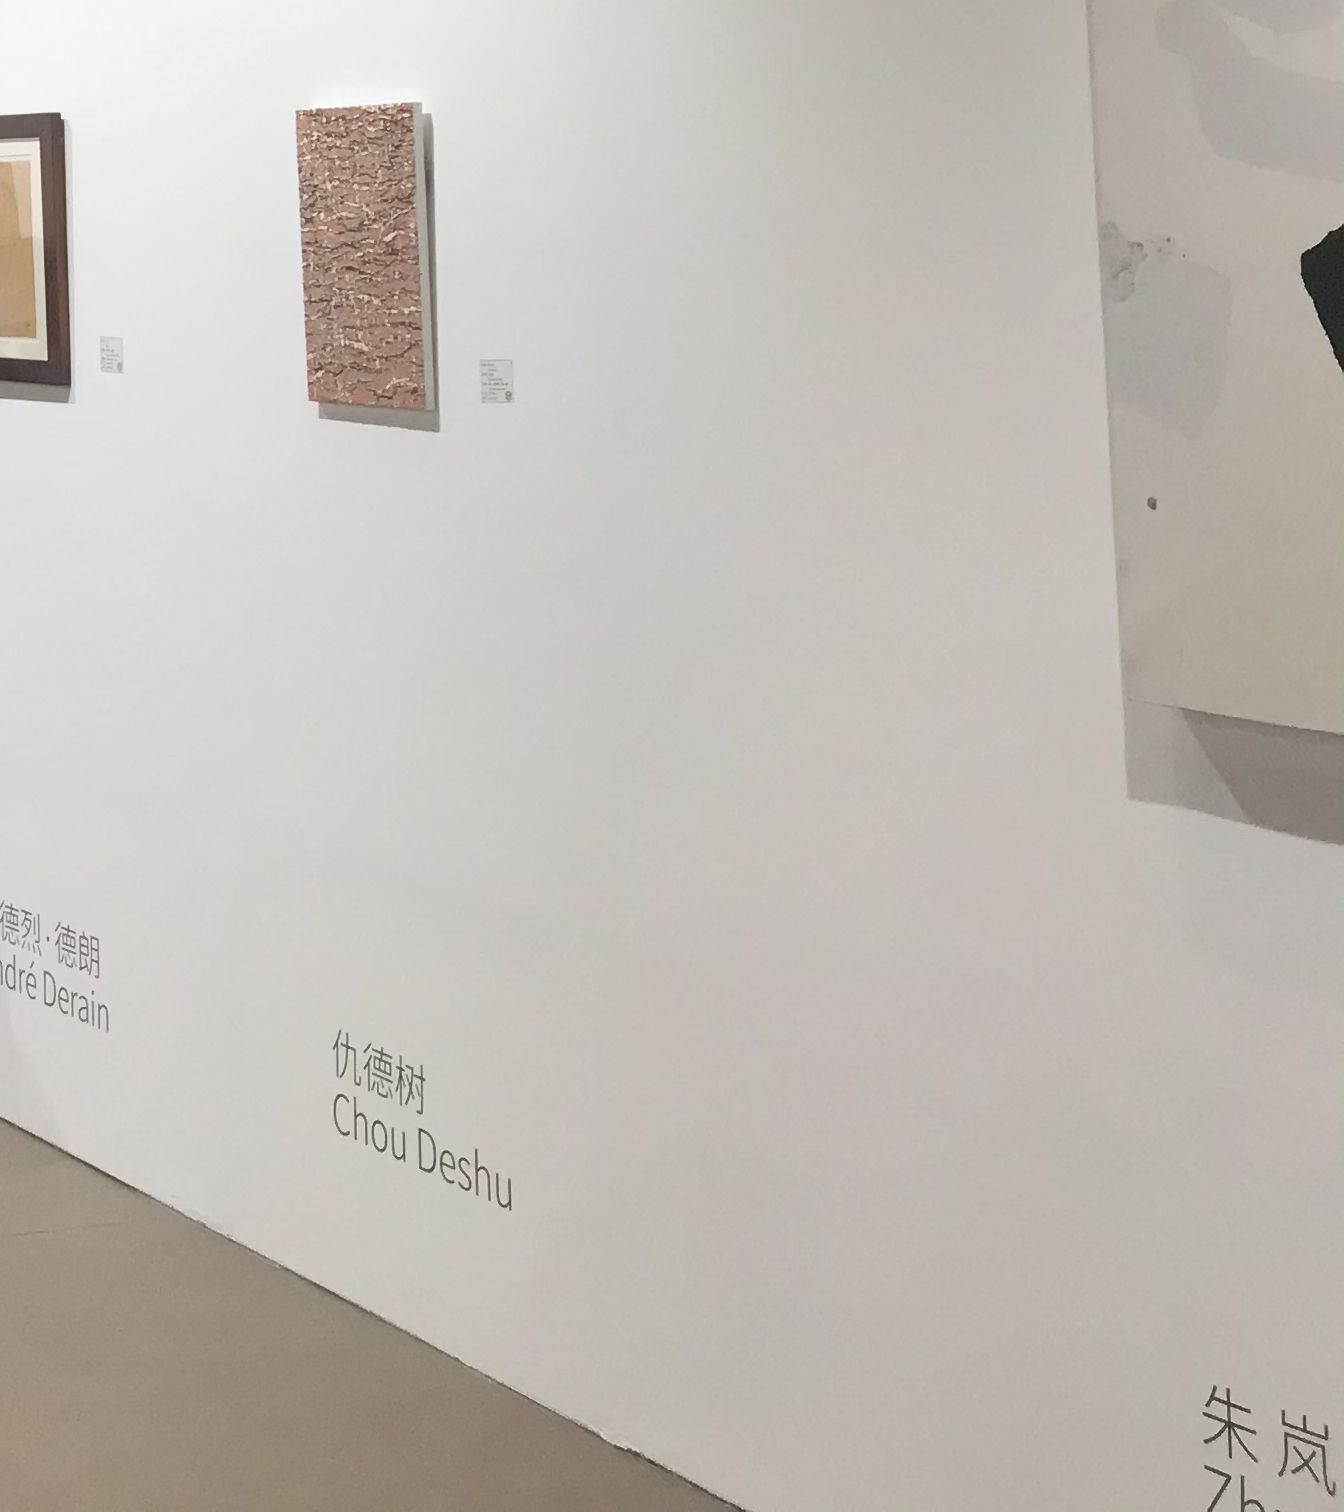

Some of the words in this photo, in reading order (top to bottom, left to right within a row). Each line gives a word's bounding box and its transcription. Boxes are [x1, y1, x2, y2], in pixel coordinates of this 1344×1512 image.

[43, 970, 110, 1033] Derain
[332, 1029, 427, 1115] 仇德树
[333, 1093, 406, 1163] Chou
[417, 1127, 513, 1211] Deshu
[1203, 1464, 1281, 1512] Zh
